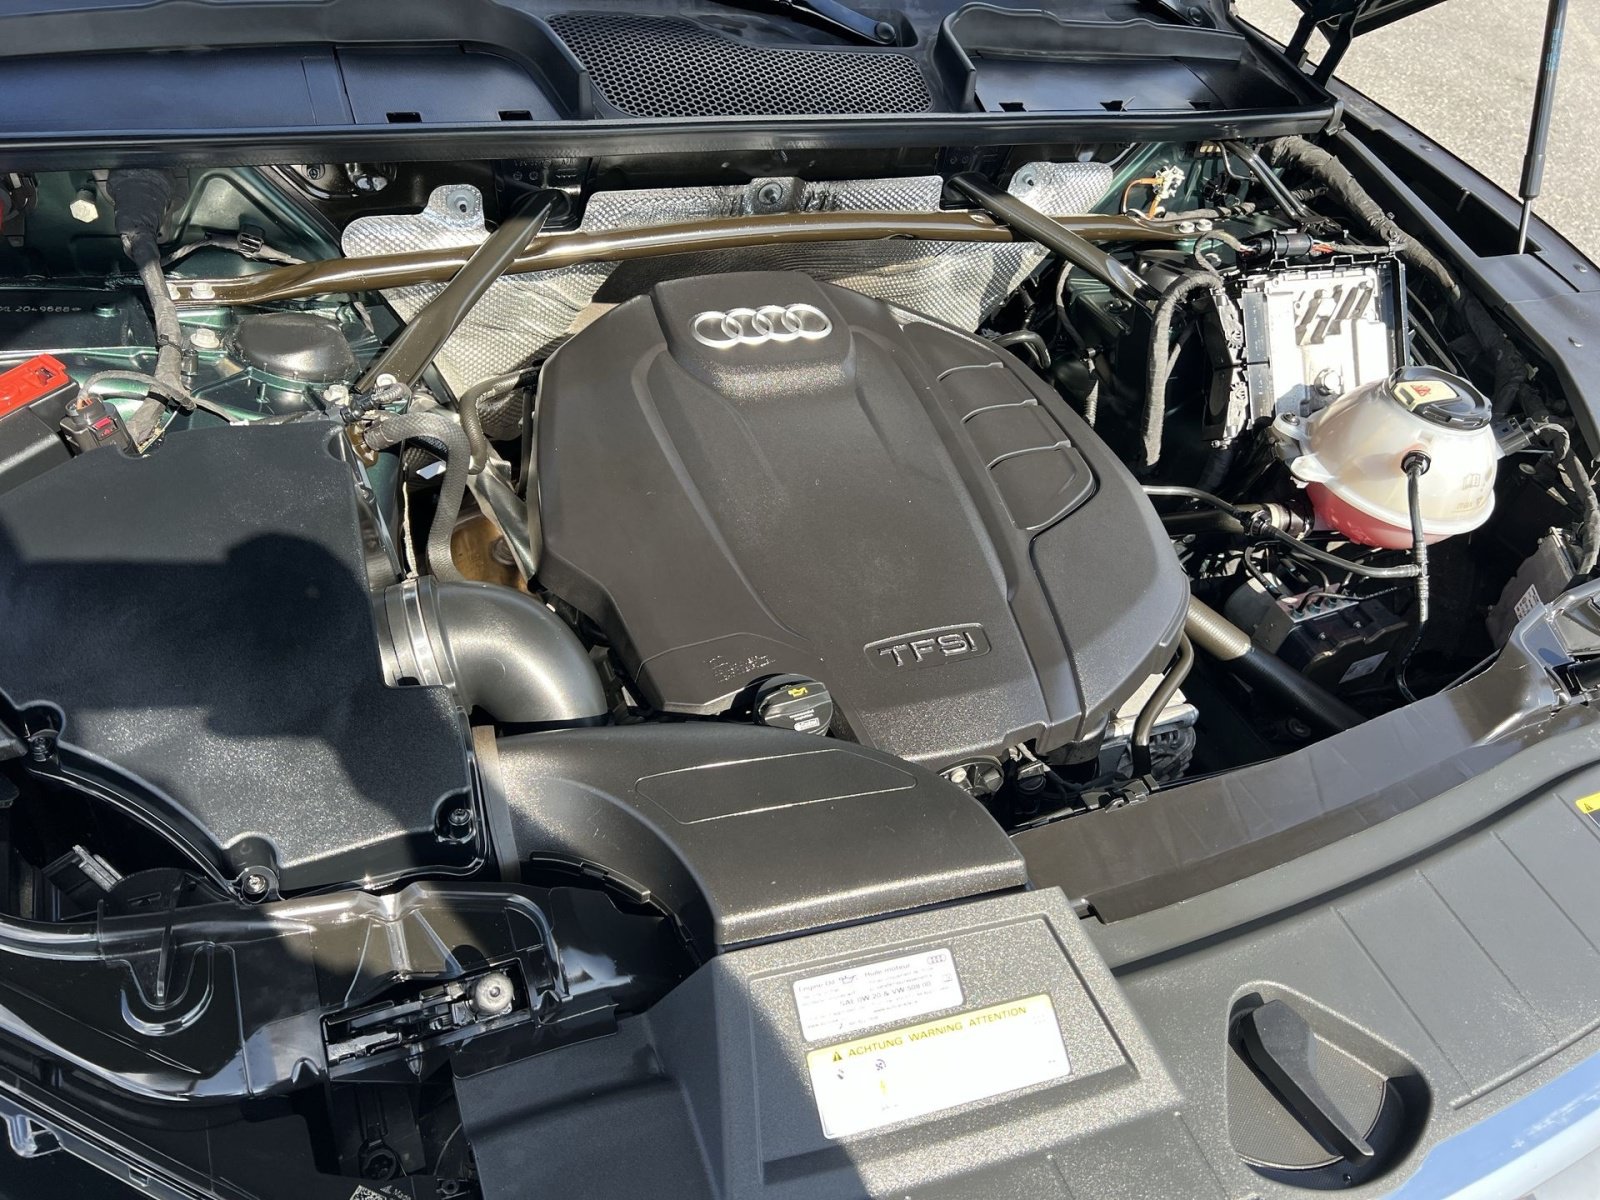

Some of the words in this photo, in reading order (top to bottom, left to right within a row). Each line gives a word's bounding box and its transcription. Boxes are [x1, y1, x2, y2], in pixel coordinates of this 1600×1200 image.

[877, 631, 978, 667] TFSI
[884, 963, 911, 974] moteur
[891, 986, 905, 996] VW
[848, 1036, 903, 1057] ACHTUNG
[908, 1021, 963, 1042] WARNING
[968, 1006, 1027, 1028] ATTENTION
